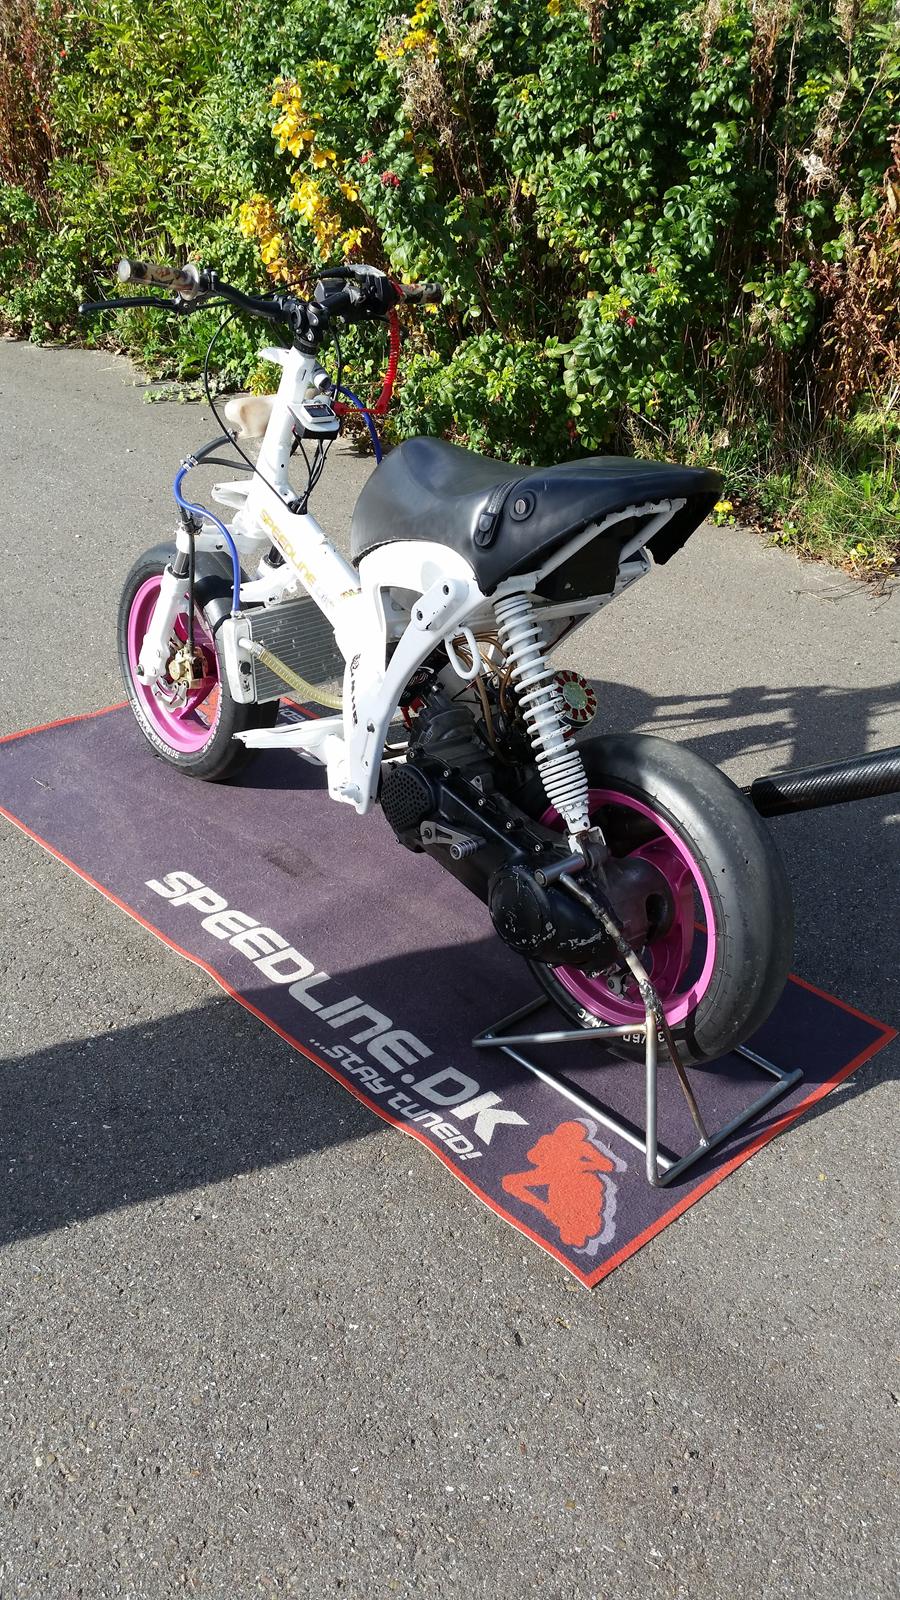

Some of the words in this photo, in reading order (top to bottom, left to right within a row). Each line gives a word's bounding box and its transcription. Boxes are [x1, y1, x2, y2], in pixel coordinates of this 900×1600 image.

[149, 733, 179, 759] SCOOTER
[144, 871, 529, 1146] SPEEDLINE.DK
[387, 1092, 483, 1161] TUNED!
